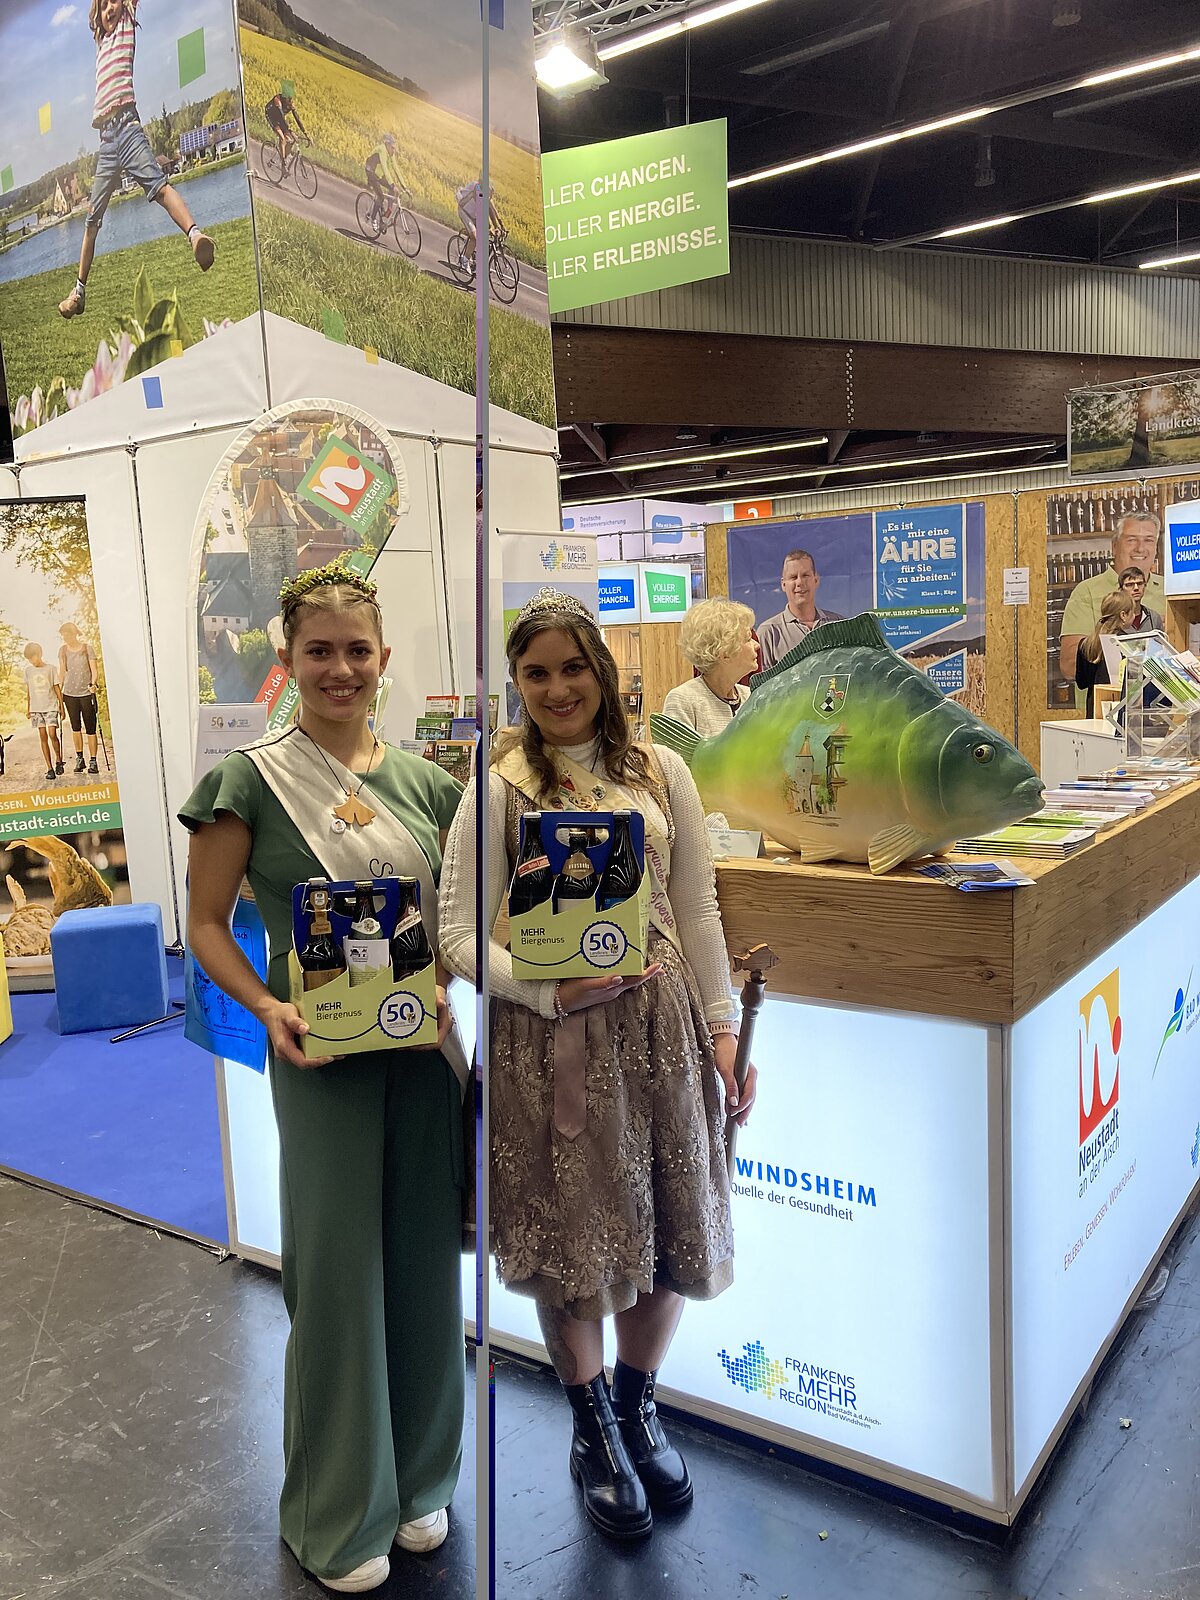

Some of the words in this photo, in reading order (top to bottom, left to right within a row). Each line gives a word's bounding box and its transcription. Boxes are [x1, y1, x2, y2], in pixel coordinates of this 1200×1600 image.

[543, 182, 585, 208] LER
[590, 154, 692, 197] CHANCEN.
[608, 191, 701, 230] ENERGIE.
[547, 255, 587, 280] LER
[593, 226, 722, 270] ERLEBNISSE.
[350, 478, 384, 522] Neustadt
[360, 515, 369, 527] an
[367, 502, 377, 517] der
[376, 483, 390, 504] Aisch
[580, 519, 627, 528] Rentenversicherung
[901, 521, 914, 530] ist
[907, 529, 926, 538] mir
[927, 528, 949, 537] eine
[567, 552, 587, 562] MEHR
[880, 536, 957, 564] ÄHRE
[901, 565, 915, 573] für
[917, 564, 932, 572] Sie
[652, 584, 676, 592] VOLLER
[928, 668, 962, 676] Unsere
[31, 787, 111, 806] WOHLFÜHLEN!
[520, 928, 546, 936] MEHR
[521, 937, 565, 946] Biergenuss
[589, 932, 617, 951] 50
[316, 1002, 342, 1011] MEHR
[316, 1009, 362, 1021] Biergenuss
[386, 1002, 414, 1022] 50
[1078, 1107, 1119, 1178] Neustadt
[1078, 1177, 1088, 1199] an
[1089, 1158, 1101, 1184] der
[1102, 1132, 1120, 1168] Aisch
[735, 1157, 877, 1208] WINDSHEIM
[730, 1182, 764, 1200] Quelle
[767, 1190, 786, 1205] der
[788, 1195, 854, 1222] Gesundheit
[785, 1357, 856, 1390] FRANKENS
[779, 1388, 827, 1415] REGION
[798, 1374, 857, 1411] MEHR
[827, 1403, 852, 1417] Neustadt
[827, 1410, 839, 1419] Bad
[839, 1414, 871, 1430] Windsheim
